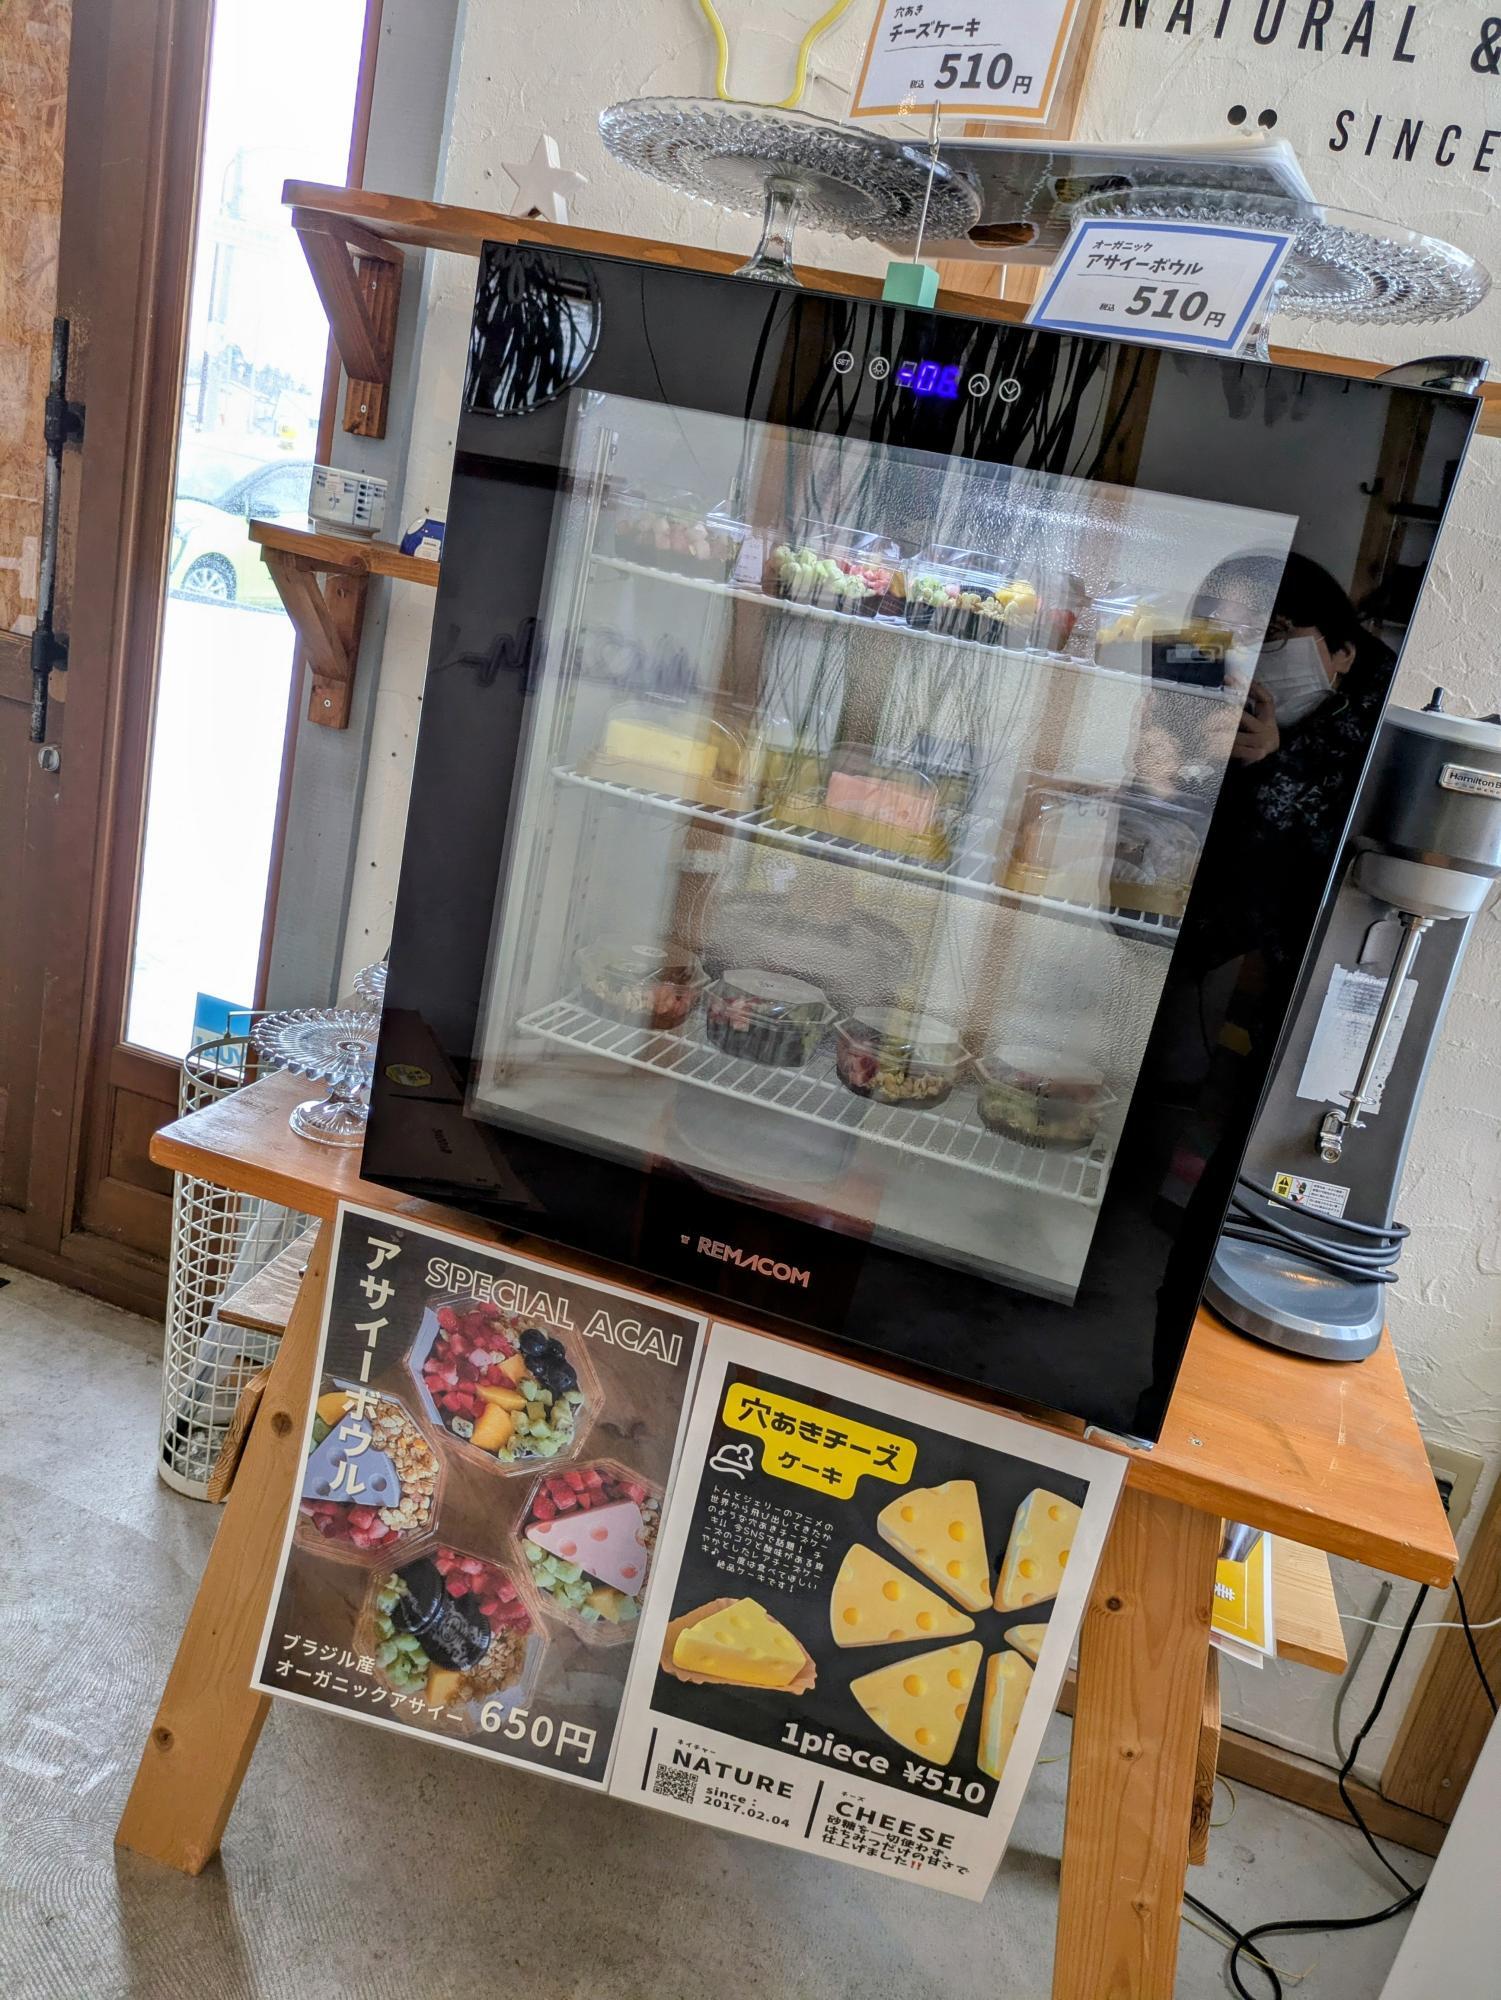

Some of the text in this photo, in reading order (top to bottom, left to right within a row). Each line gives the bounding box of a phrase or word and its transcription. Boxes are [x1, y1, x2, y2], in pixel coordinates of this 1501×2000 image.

[889, 18, 981, 42] チーズケーキ
[894, 4, 924, 19] 穴あき
[1470, 17, 1501, 75] &
[909, 52, 1033, 95] 税込 510円
[1329, 109, 1501, 173] SINCE
[1086, 253, 1204, 276] アサイーボウル
[1092, 239, 1154, 252] オーガニック
[1099, 286, 1227, 328] 税込 510円
[1449, 772, 1495, 787] Hamilton
[697, 1235, 811, 1288] REMACOM
[424, 1257, 683, 1366] SPECIAL ACAI
[329, 1236, 402, 1495] アサイーボウル
[738, 1397, 901, 1472] 穴あきチーズ
[778, 1451, 842, 1485] ケーキ
[713, 1485, 834, 1531] トムとジェリーのアニメの
[283, 1633, 376, 1676] ブラジル産
[275, 1659, 464, 1722] オーガニックアサイー
[481, 1700, 597, 1764] 650円
[672, 1749, 794, 1799] NATURE
[781, 1722, 986, 1804] 1piece ¥510
[703, 1796, 790, 1828] 2017.02.04
[841, 1791, 865, 1802] チーズ
[836, 1801, 955, 1850] CHEESE
[825, 1824, 970, 1875] はちみつだけの甘さで
